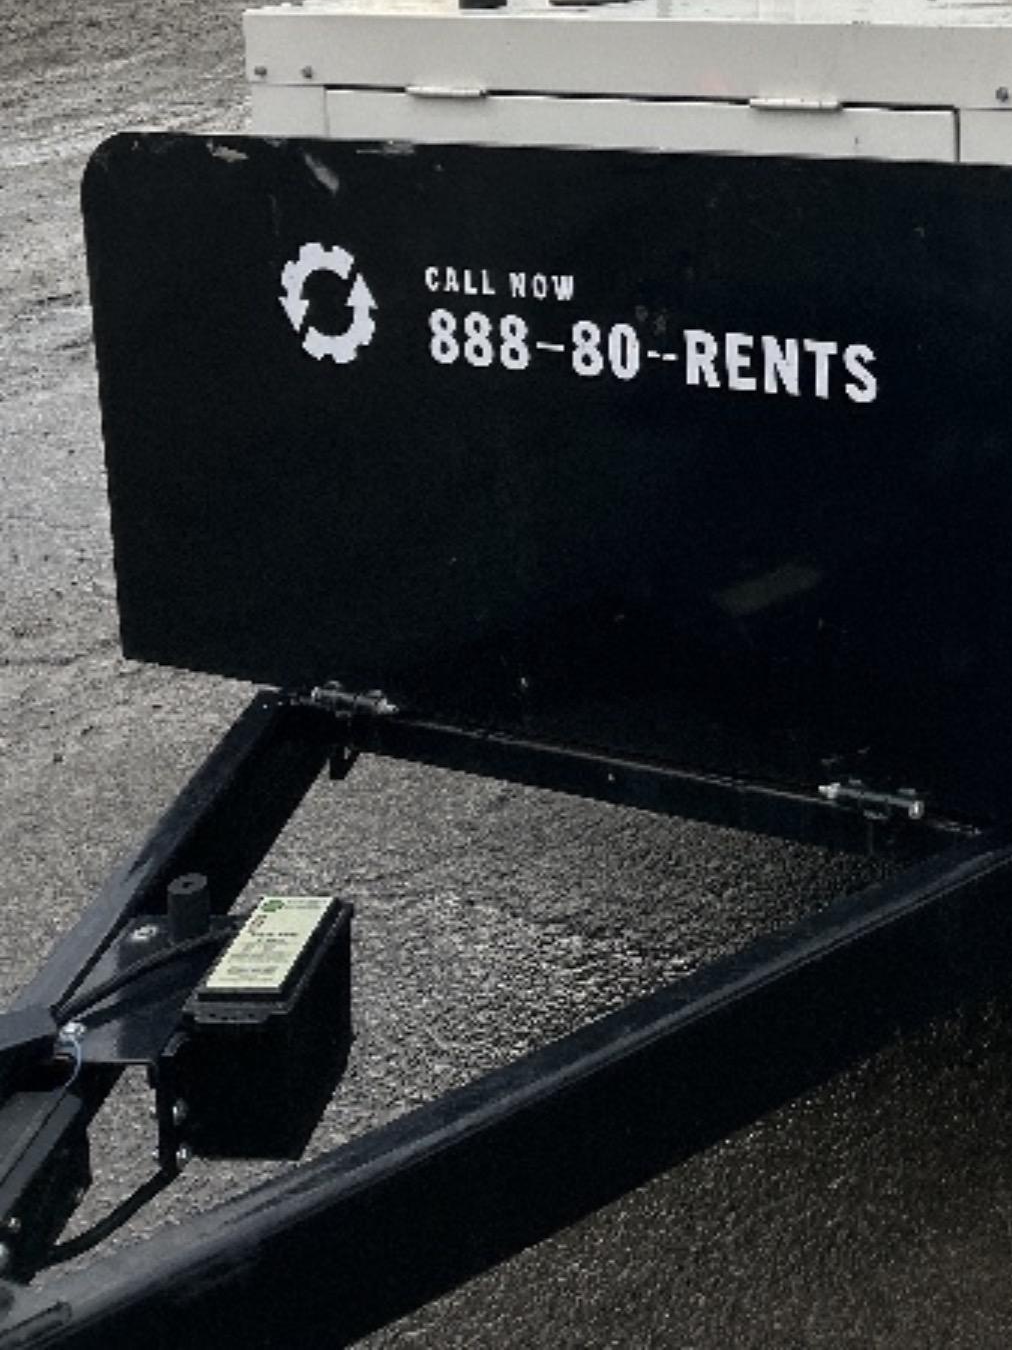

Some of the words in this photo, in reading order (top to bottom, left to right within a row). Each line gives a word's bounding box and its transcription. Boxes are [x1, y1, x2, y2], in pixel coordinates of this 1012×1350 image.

[424, 266, 496, 296] CALL
[509, 271, 575, 302] NOW
[428, 308, 878, 404] 888-80-RENTS
